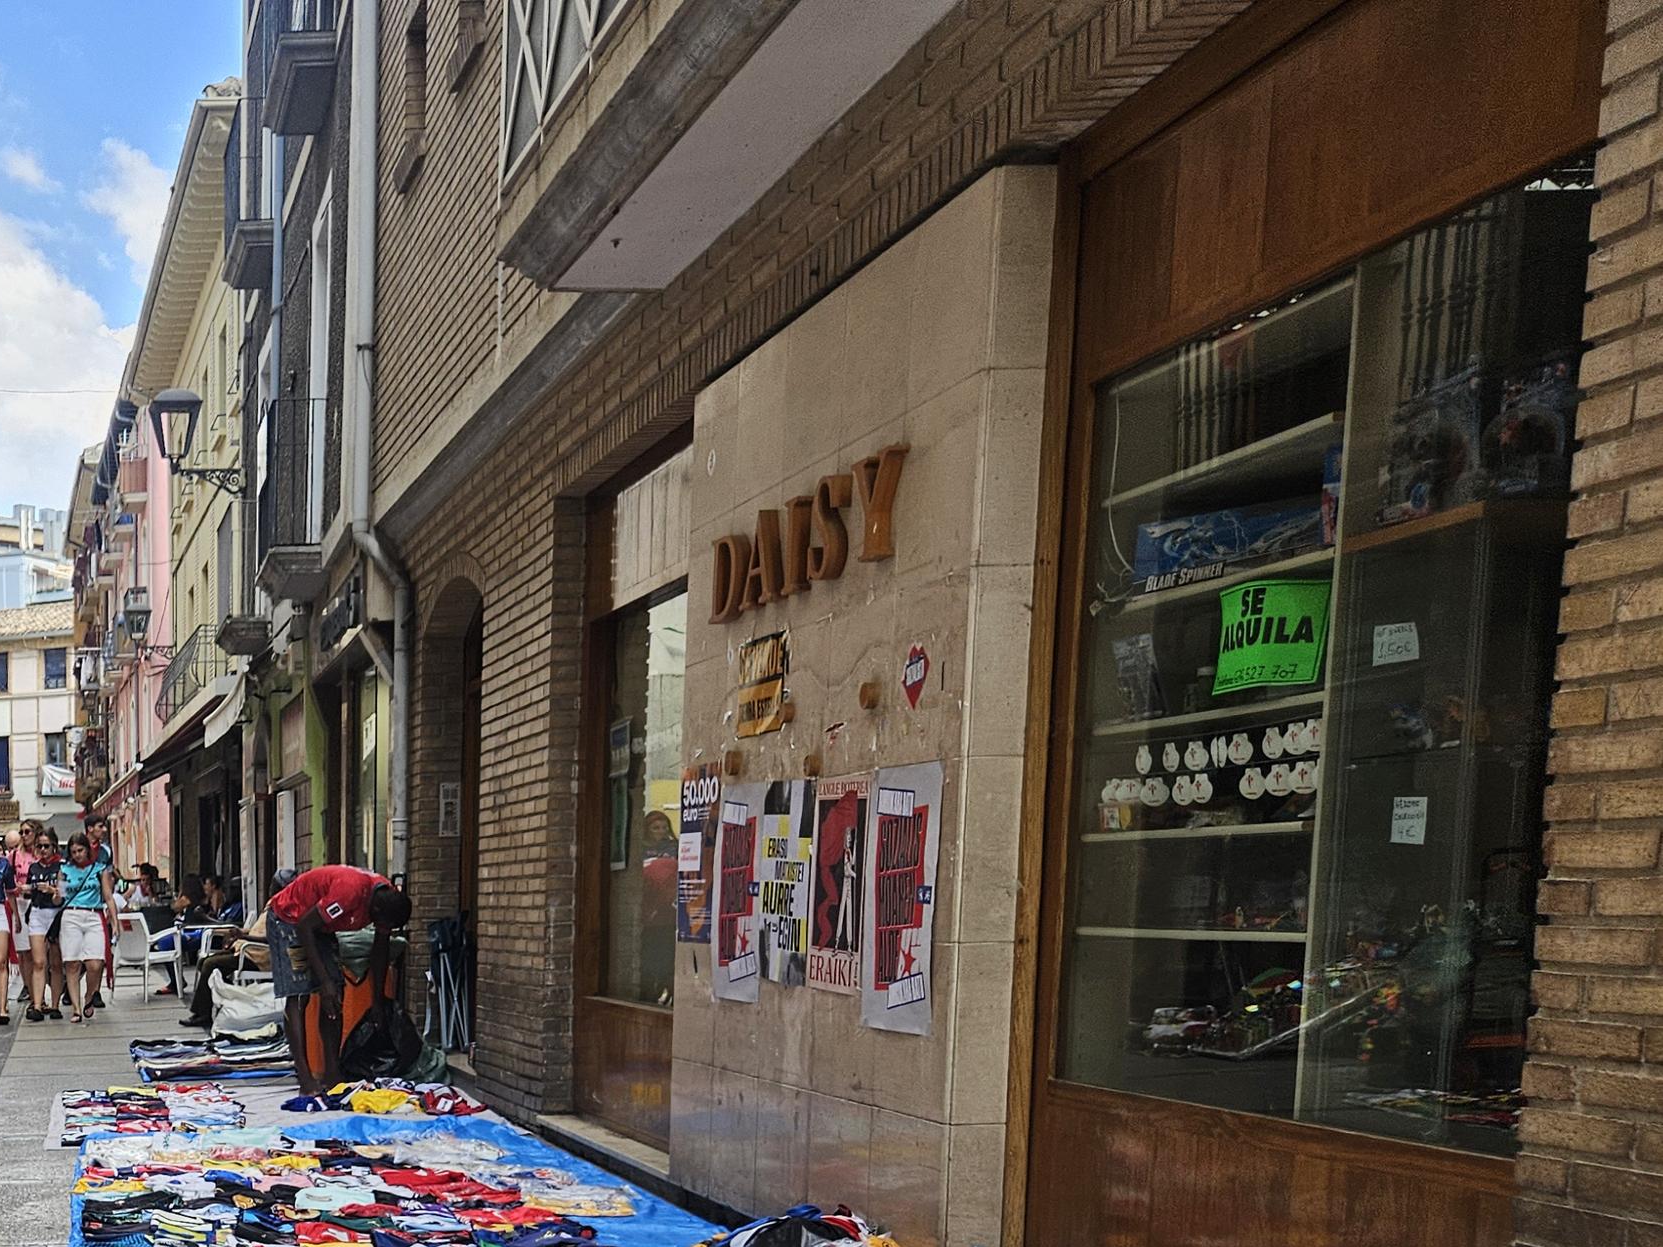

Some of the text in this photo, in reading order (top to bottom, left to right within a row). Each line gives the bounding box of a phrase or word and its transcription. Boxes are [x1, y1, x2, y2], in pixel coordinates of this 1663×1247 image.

[709, 442, 912, 624] DAISY
[1144, 562, 1225, 593] BLADE SPINNER
[1241, 587, 1267, 618] SE
[1221, 614, 1315, 654] ALQUILA
[682, 776, 720, 806] 50.000
[682, 808, 699, 822] euro
[762, 882, 795, 916] AURRE
[777, 915, 801, 952] EGIN
[809, 954, 853, 987] ERAIKI
